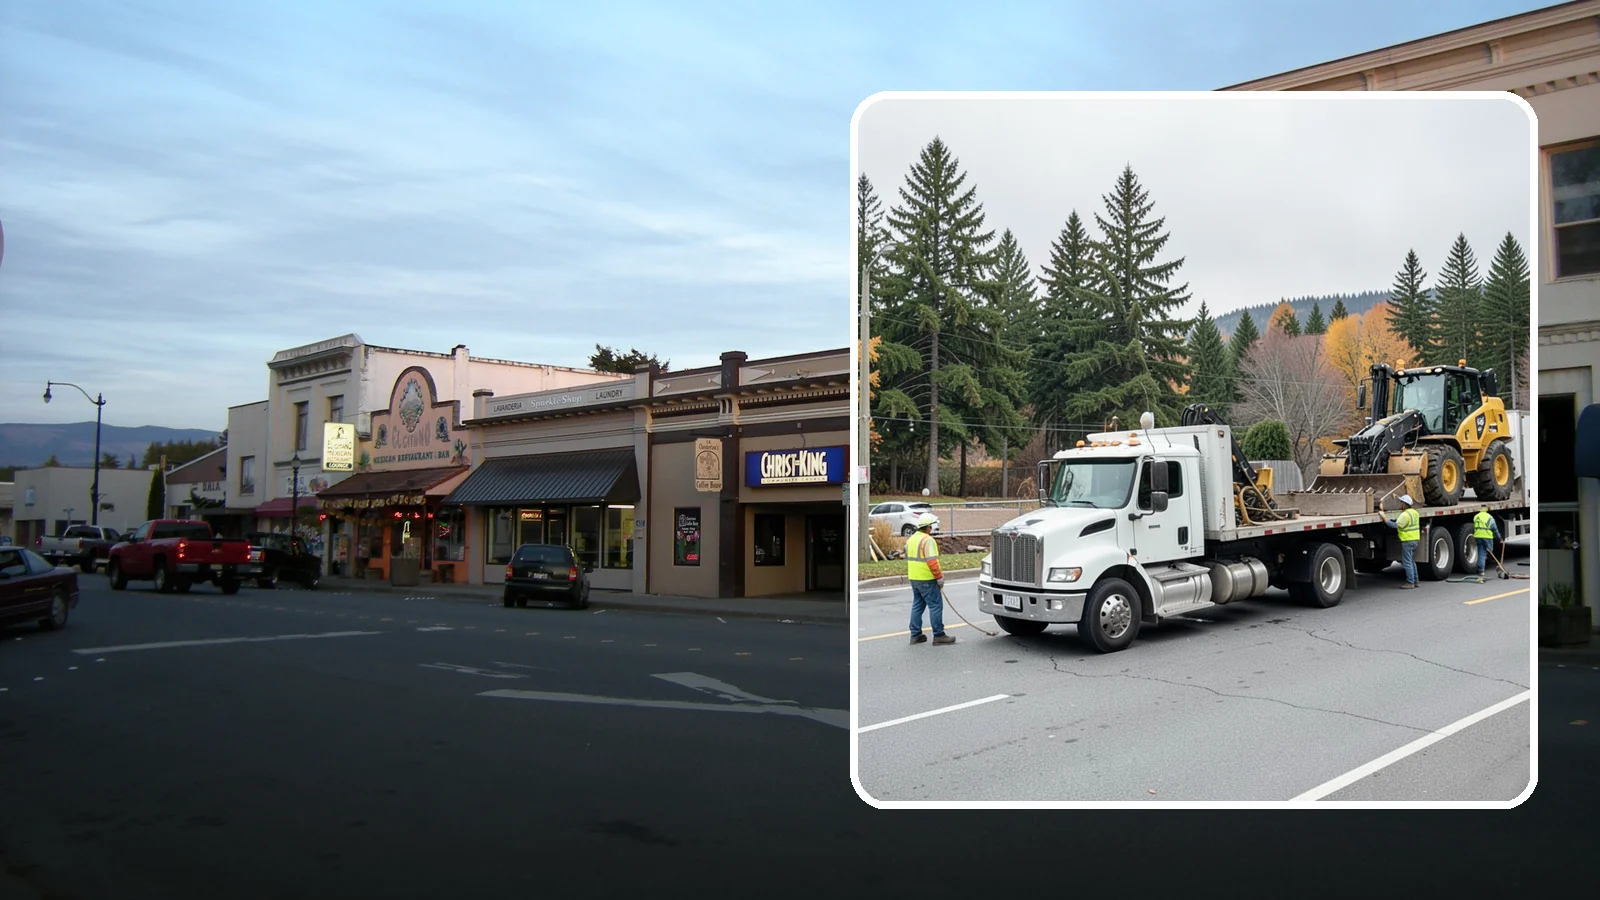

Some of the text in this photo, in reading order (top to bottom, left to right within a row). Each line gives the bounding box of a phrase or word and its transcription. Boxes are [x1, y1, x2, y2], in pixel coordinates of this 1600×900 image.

[595, 389, 624, 400] LAUNDRY
[562, 395, 582, 407] Shop
[493, 402, 523, 413] LAVANDERIA
[373, 454, 396, 464] MEXICAN
[397, 451, 433, 462] RESTAURANT
[437, 450, 450, 459] BAR
[761, 450, 827, 478] CHRIST KING
